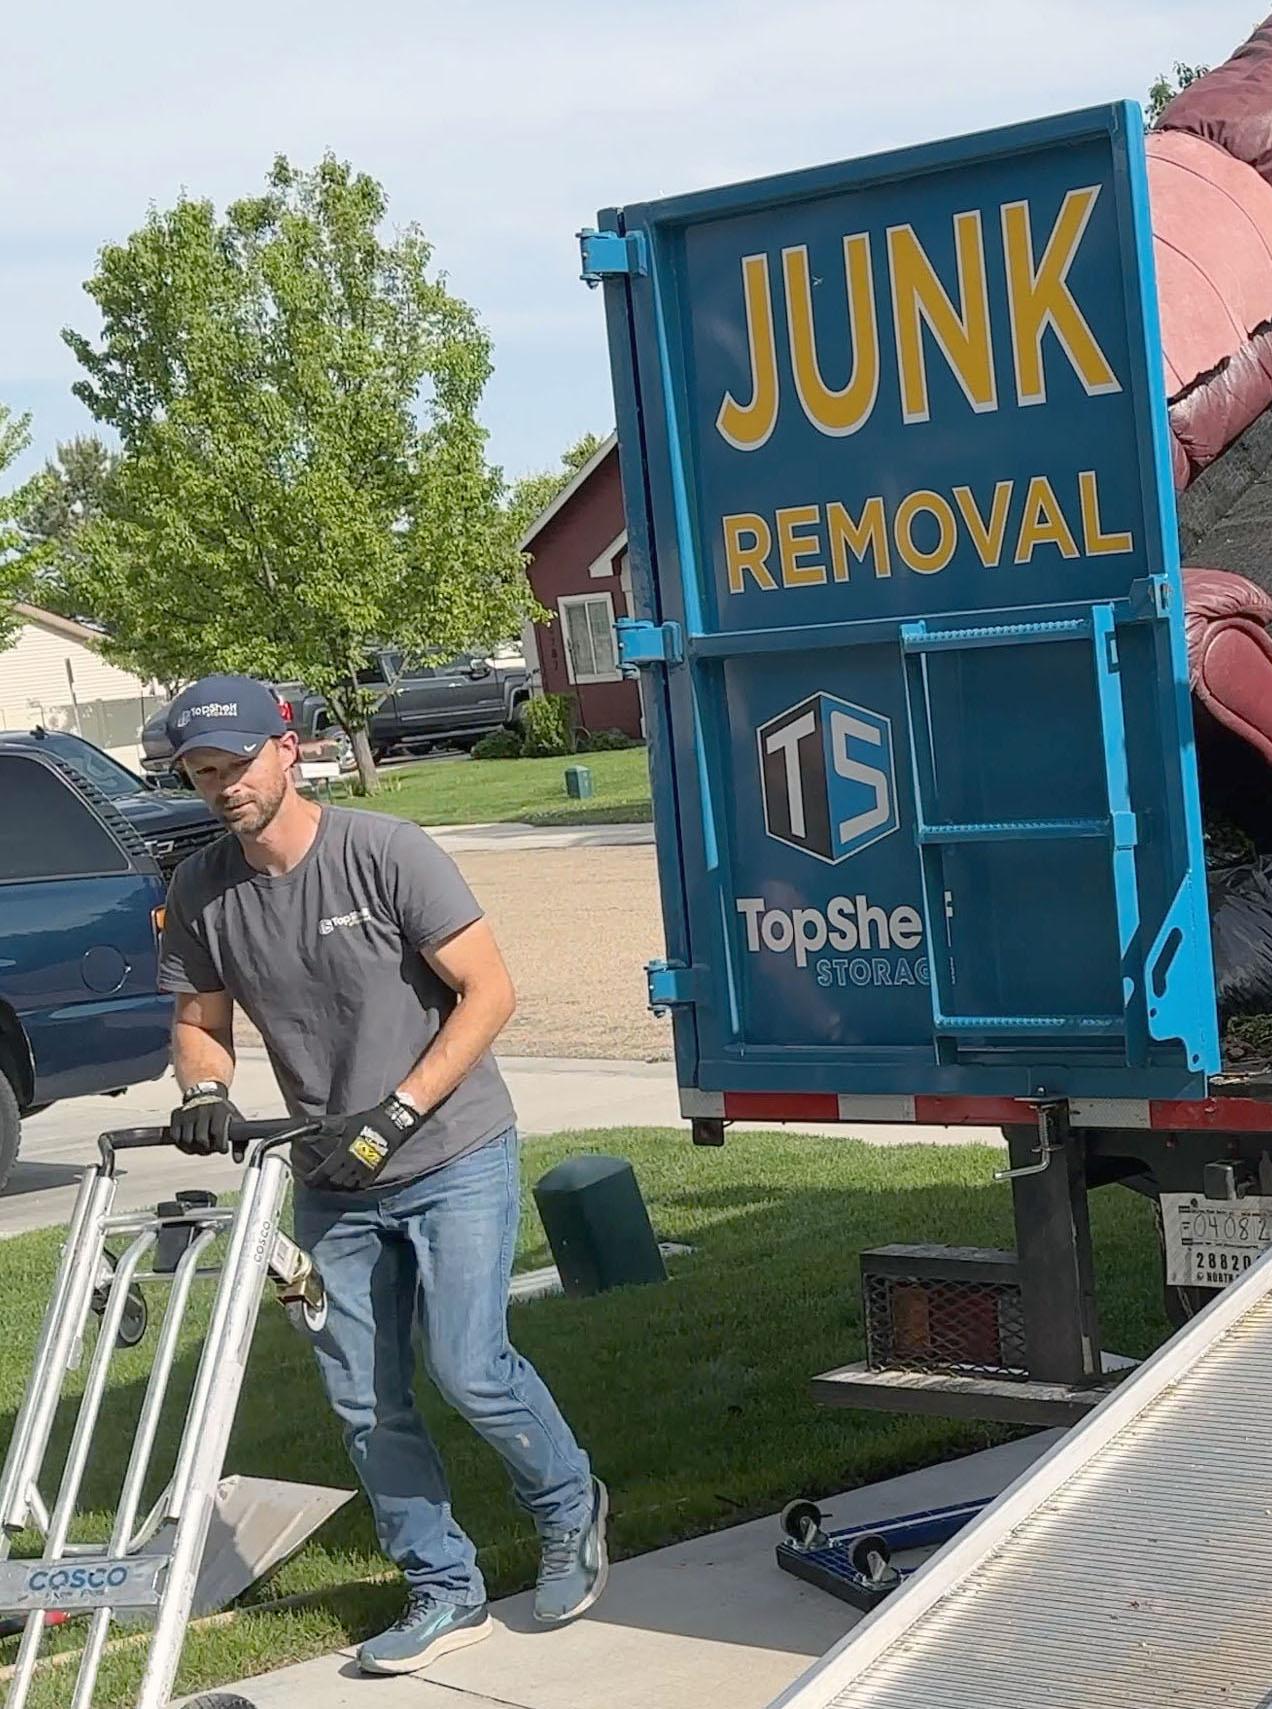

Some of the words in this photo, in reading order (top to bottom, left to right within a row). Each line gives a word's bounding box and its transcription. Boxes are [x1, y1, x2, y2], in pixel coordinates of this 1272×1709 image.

[714, 183, 1124, 452] JUNK
[722, 471, 1134, 595] REMOVAL
[736, 890, 953, 967] TopShe
[816, 956, 956, 987] STORAG
[1196, 1252, 1261, 1271] 28820
[28, 1566, 128, 1591] COSCO
